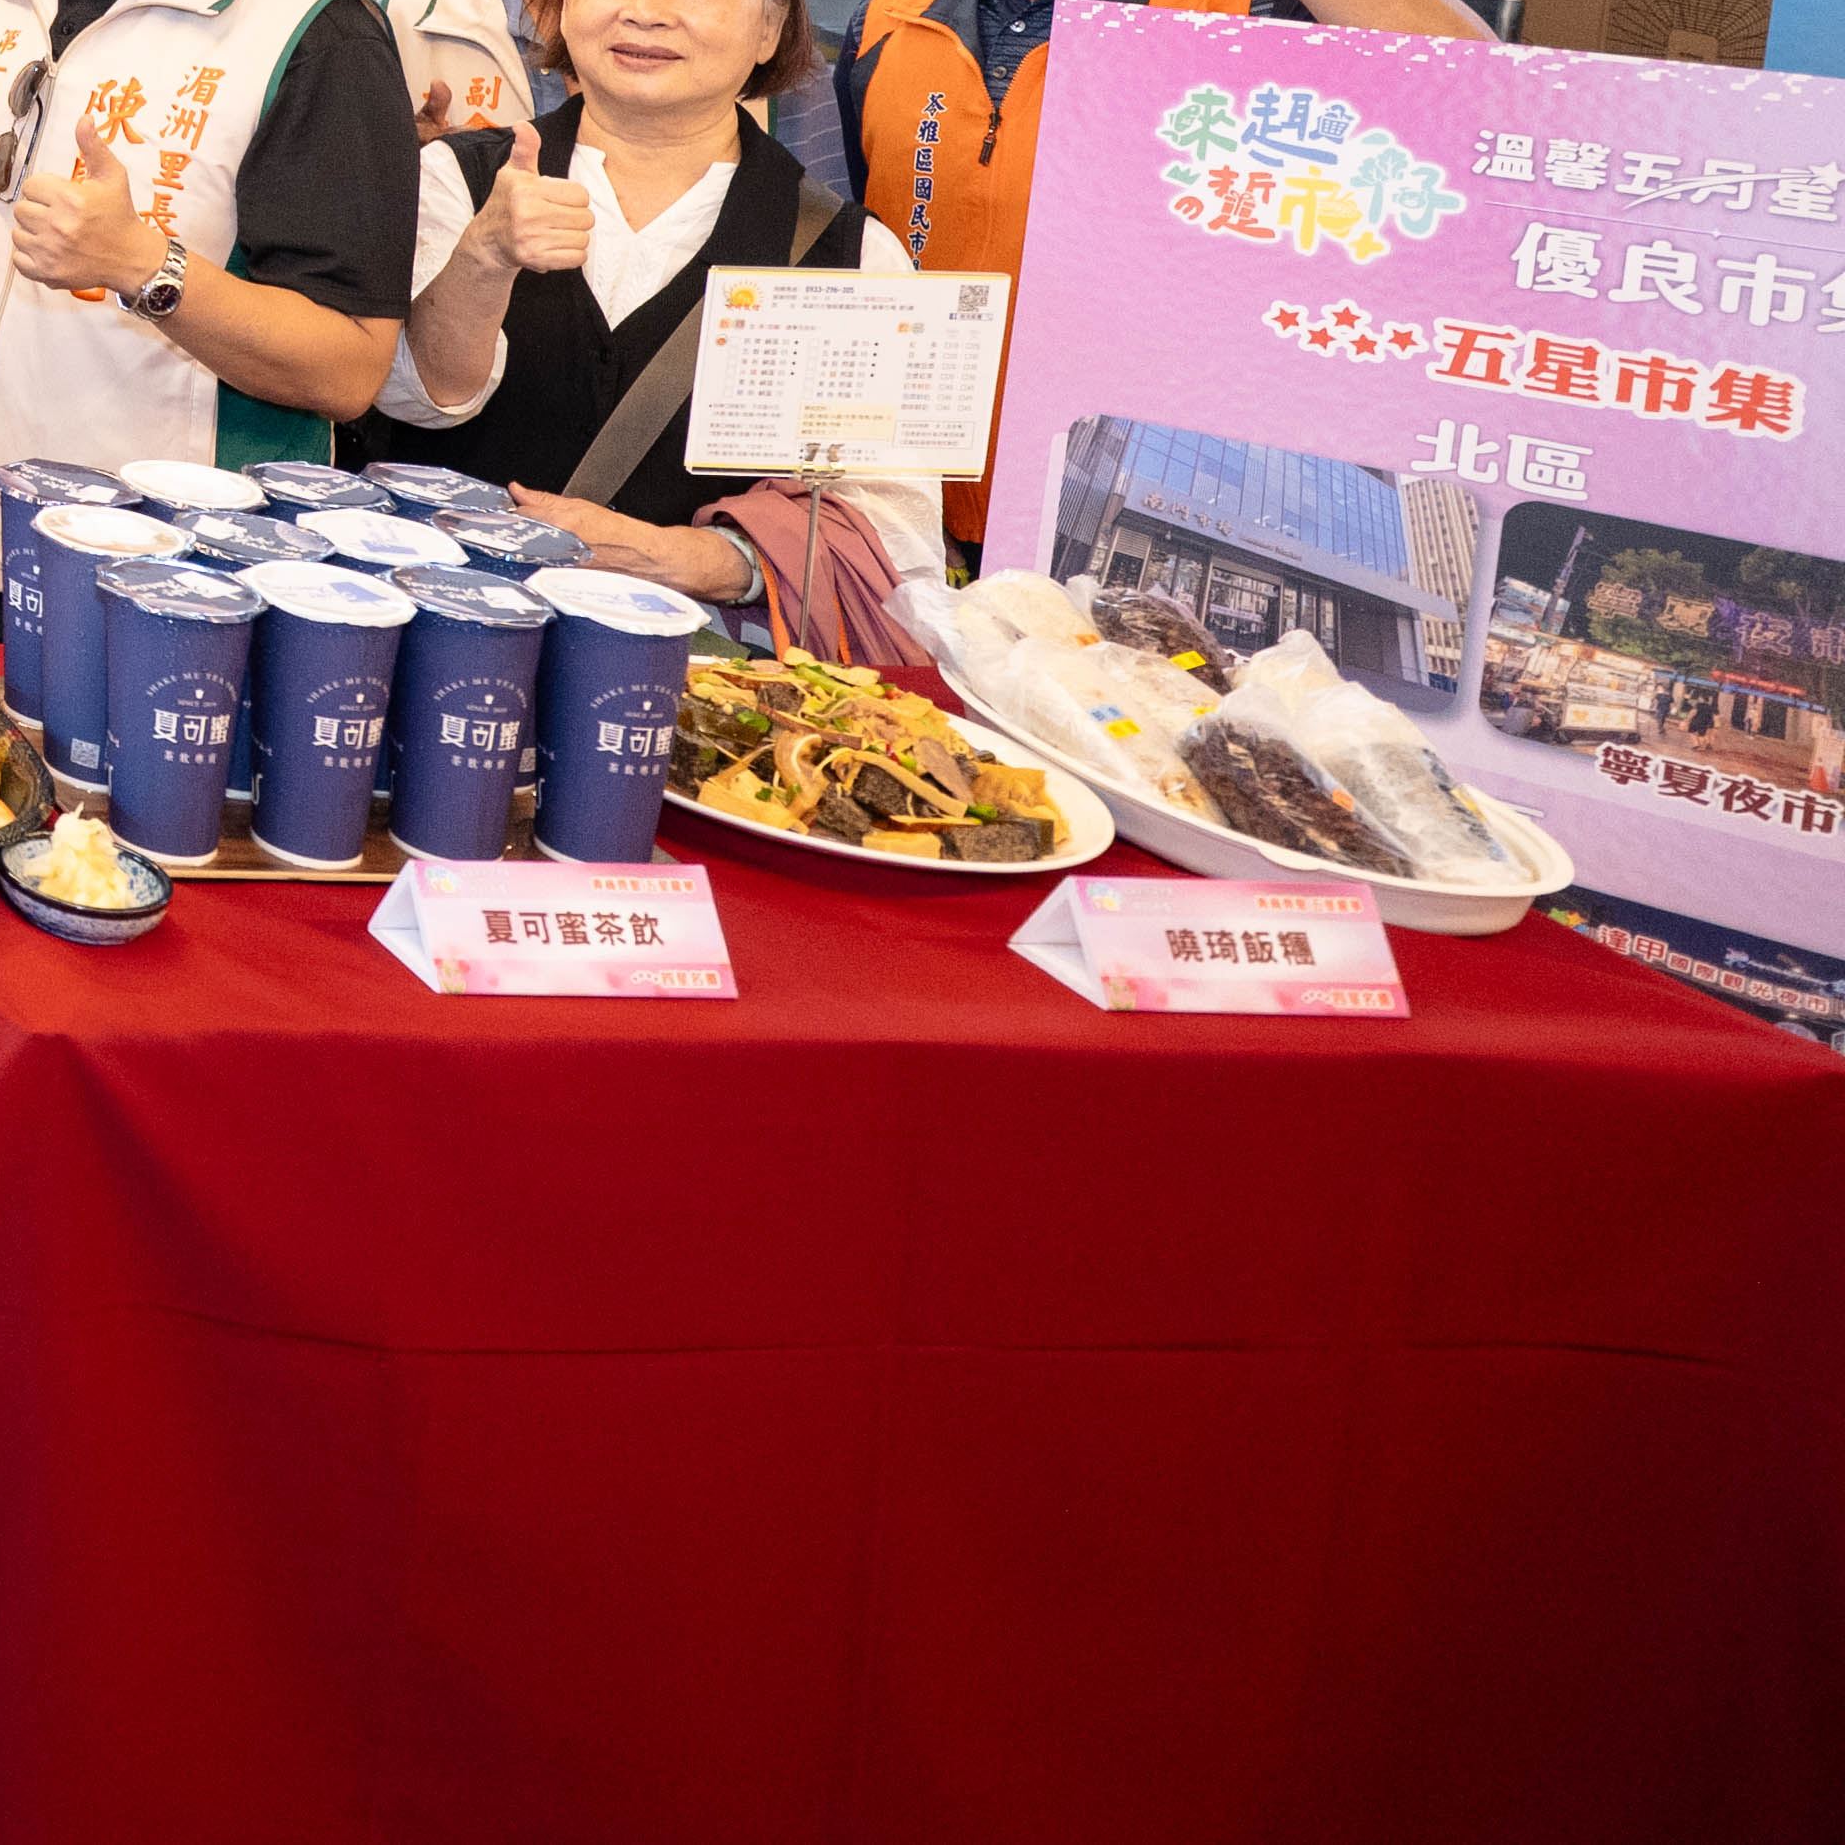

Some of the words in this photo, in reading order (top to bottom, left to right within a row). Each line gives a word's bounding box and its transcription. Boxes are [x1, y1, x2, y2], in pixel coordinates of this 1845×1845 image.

[138, 64, 226, 239] 湄洲里長
[1433, 323, 1797, 436] 五星市集
[1411, 419, 1594, 502] 北區
[152, 708, 231, 745] 夏可蜜
[312, 715, 385, 749] 夏可蜜
[439, 713, 520, 752] 夏可蜜
[597, 720, 674, 757] 夏可蜜
[1599, 745, 1838, 835] 寧夏夜市
[481, 909, 664, 946] 夏可蜜茶飲
[1165, 928, 1316, 966] 曉琦飯糰
